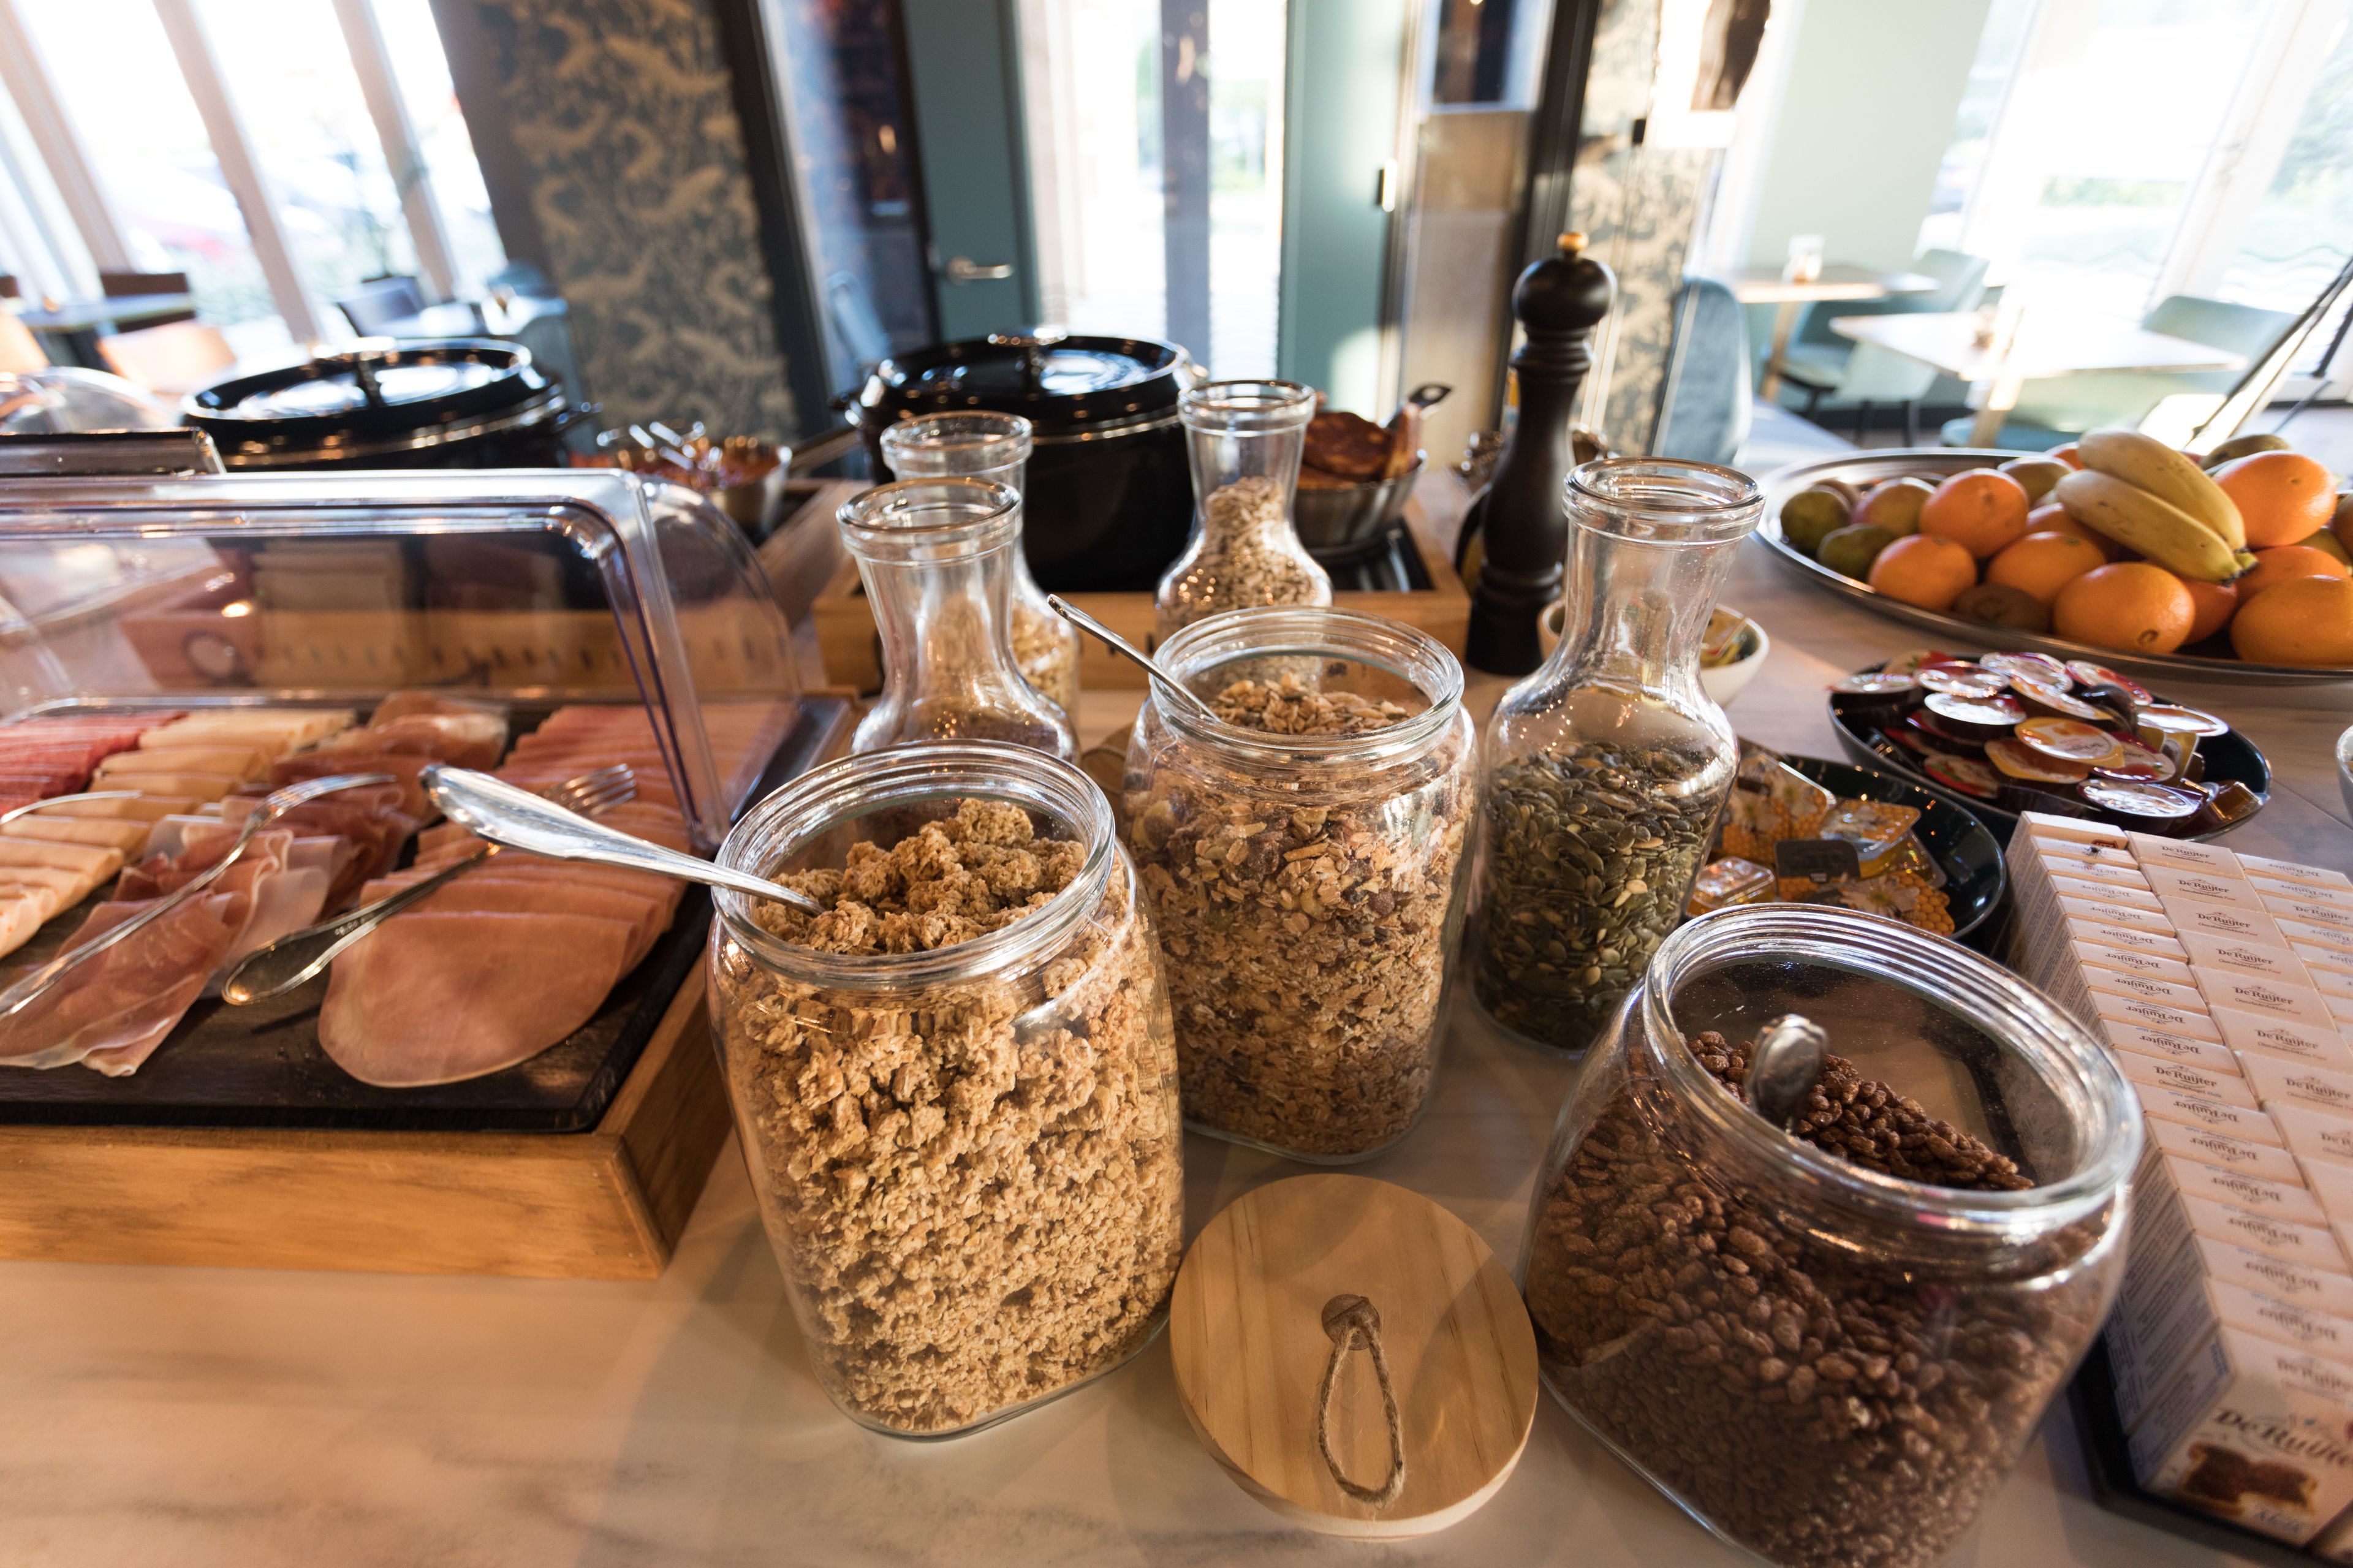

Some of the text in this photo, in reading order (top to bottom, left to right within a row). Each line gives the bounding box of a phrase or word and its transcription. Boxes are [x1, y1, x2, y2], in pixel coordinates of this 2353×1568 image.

[2192, 882, 2230, 893] Ruijter
[2211, 915, 2251, 928] Ruijter
[2101, 930, 2140, 942] Ruijter
[2105, 953, 2146, 966] Ruijter
[2232, 952, 2273, 965] Ruijter
[2115, 978, 2156, 992] Ruijter
[2232, 987, 2294, 1004] De Ruijter
[2126, 1006, 2186, 1024] De Ruijter
[2139, 1036, 2202, 1055] De Ruijter
[2254, 1029, 2319, 1049] De Ruijter
[2153, 1066, 2217, 1087] De Ruijter
[2283, 1077, 2351, 1099] De Ruijter
[2173, 1101, 2240, 1123] De Ruijter
